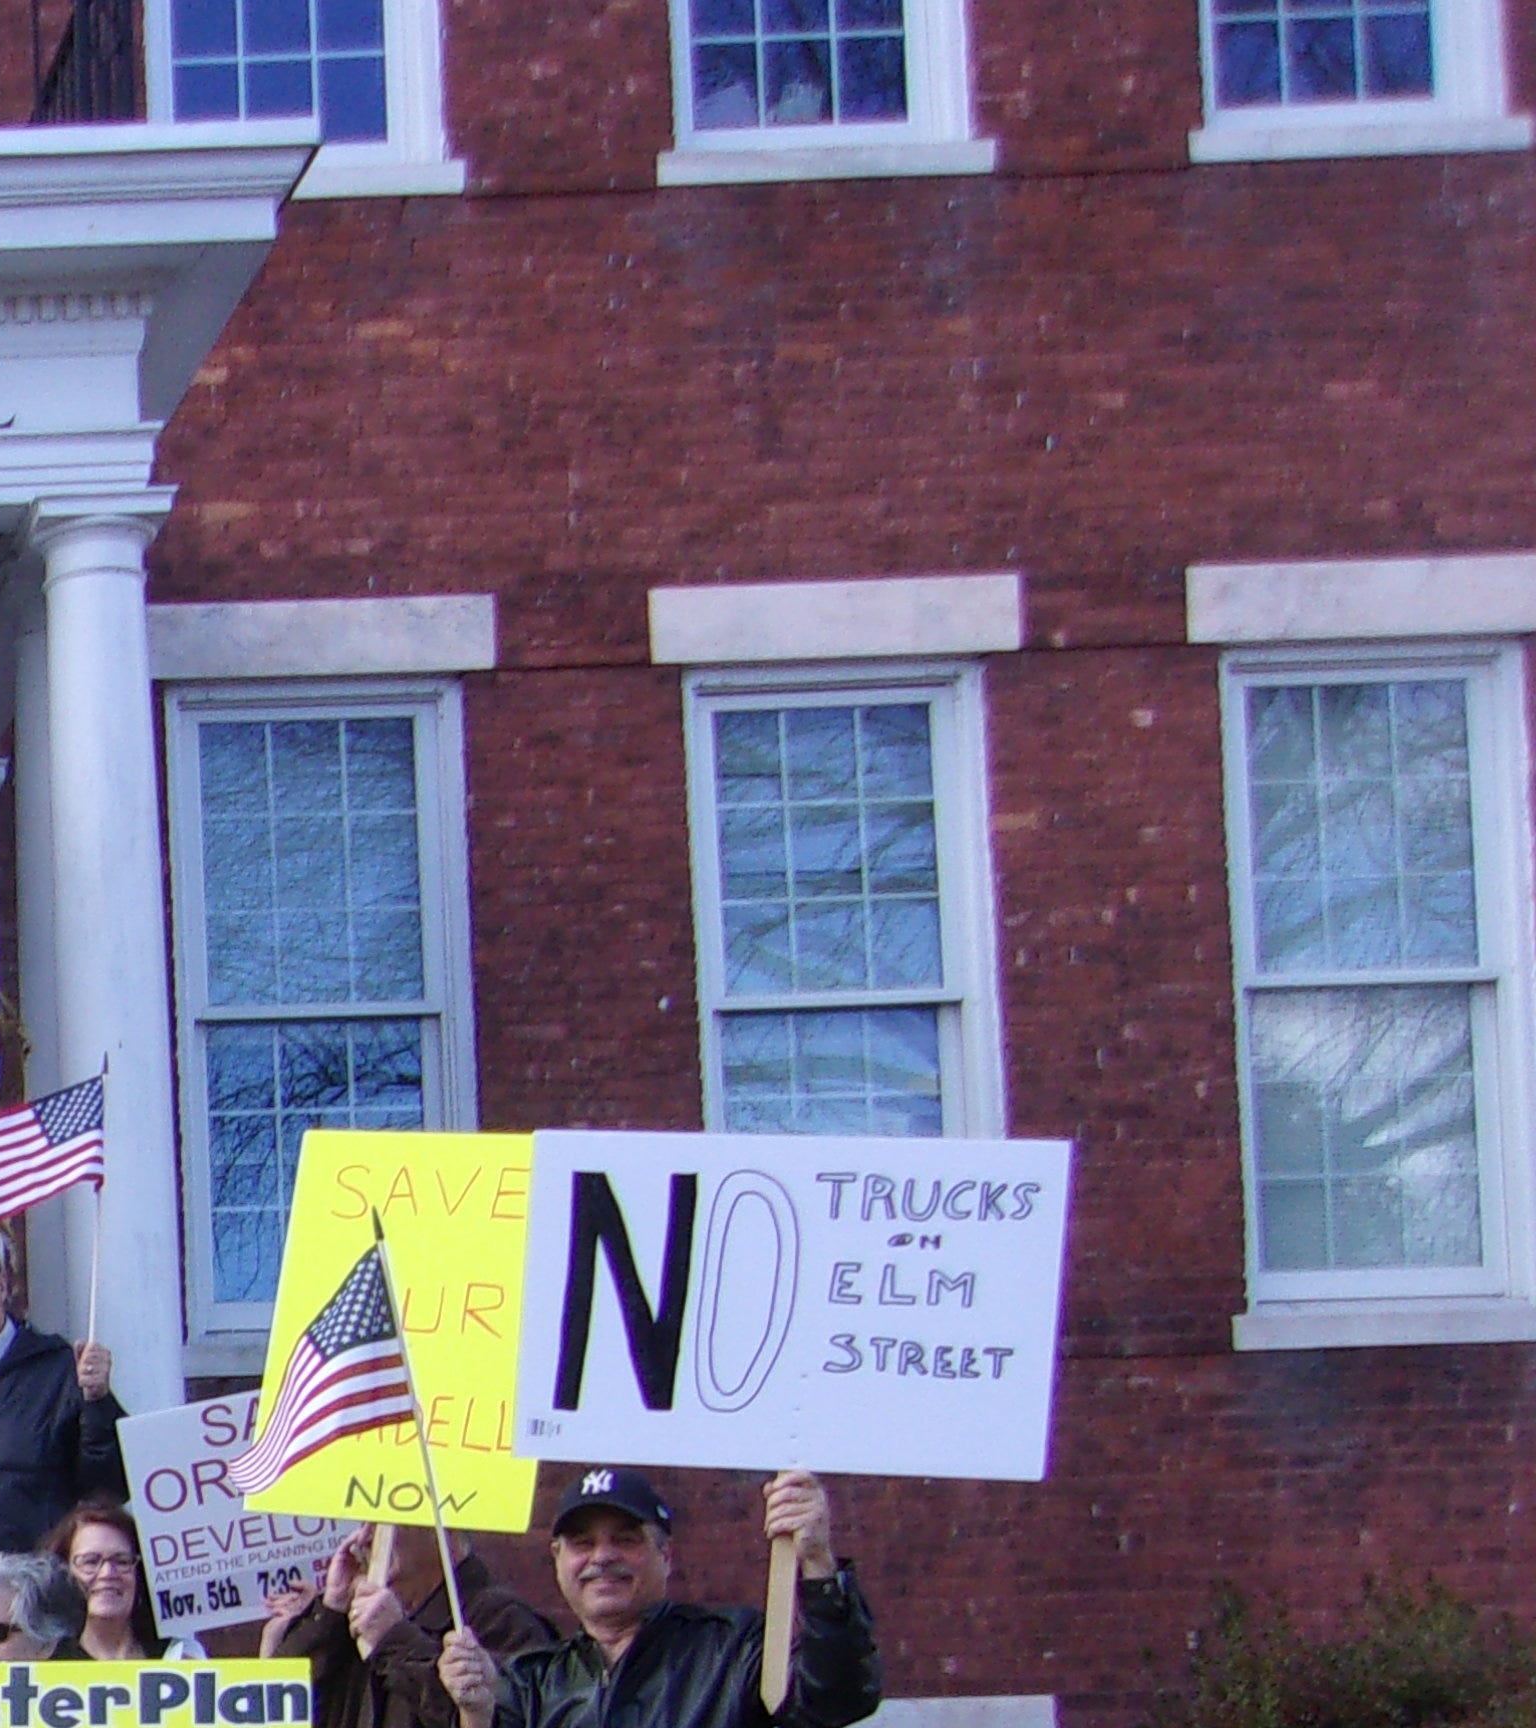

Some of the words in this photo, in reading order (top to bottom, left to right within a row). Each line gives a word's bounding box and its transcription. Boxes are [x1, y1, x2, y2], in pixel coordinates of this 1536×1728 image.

[331, 1165, 530, 1218] SAVE
[816, 1172, 1041, 1222] TRUCKS
[553, 1169, 801, 1412] NO
[828, 1262, 976, 1308] ELM
[401, 1283, 506, 1339] UR
[824, 1334, 1014, 1379] STREET
[150, 1513, 338, 1568] DEVELO
[155, 1562, 211, 1584] ATTEND
[217, 1554, 244, 1570] THE
[248, 1541, 324, 1565] PLANNING
[157, 1590, 201, 1620] Nov.
[206, 1577, 241, 1610] 5th
